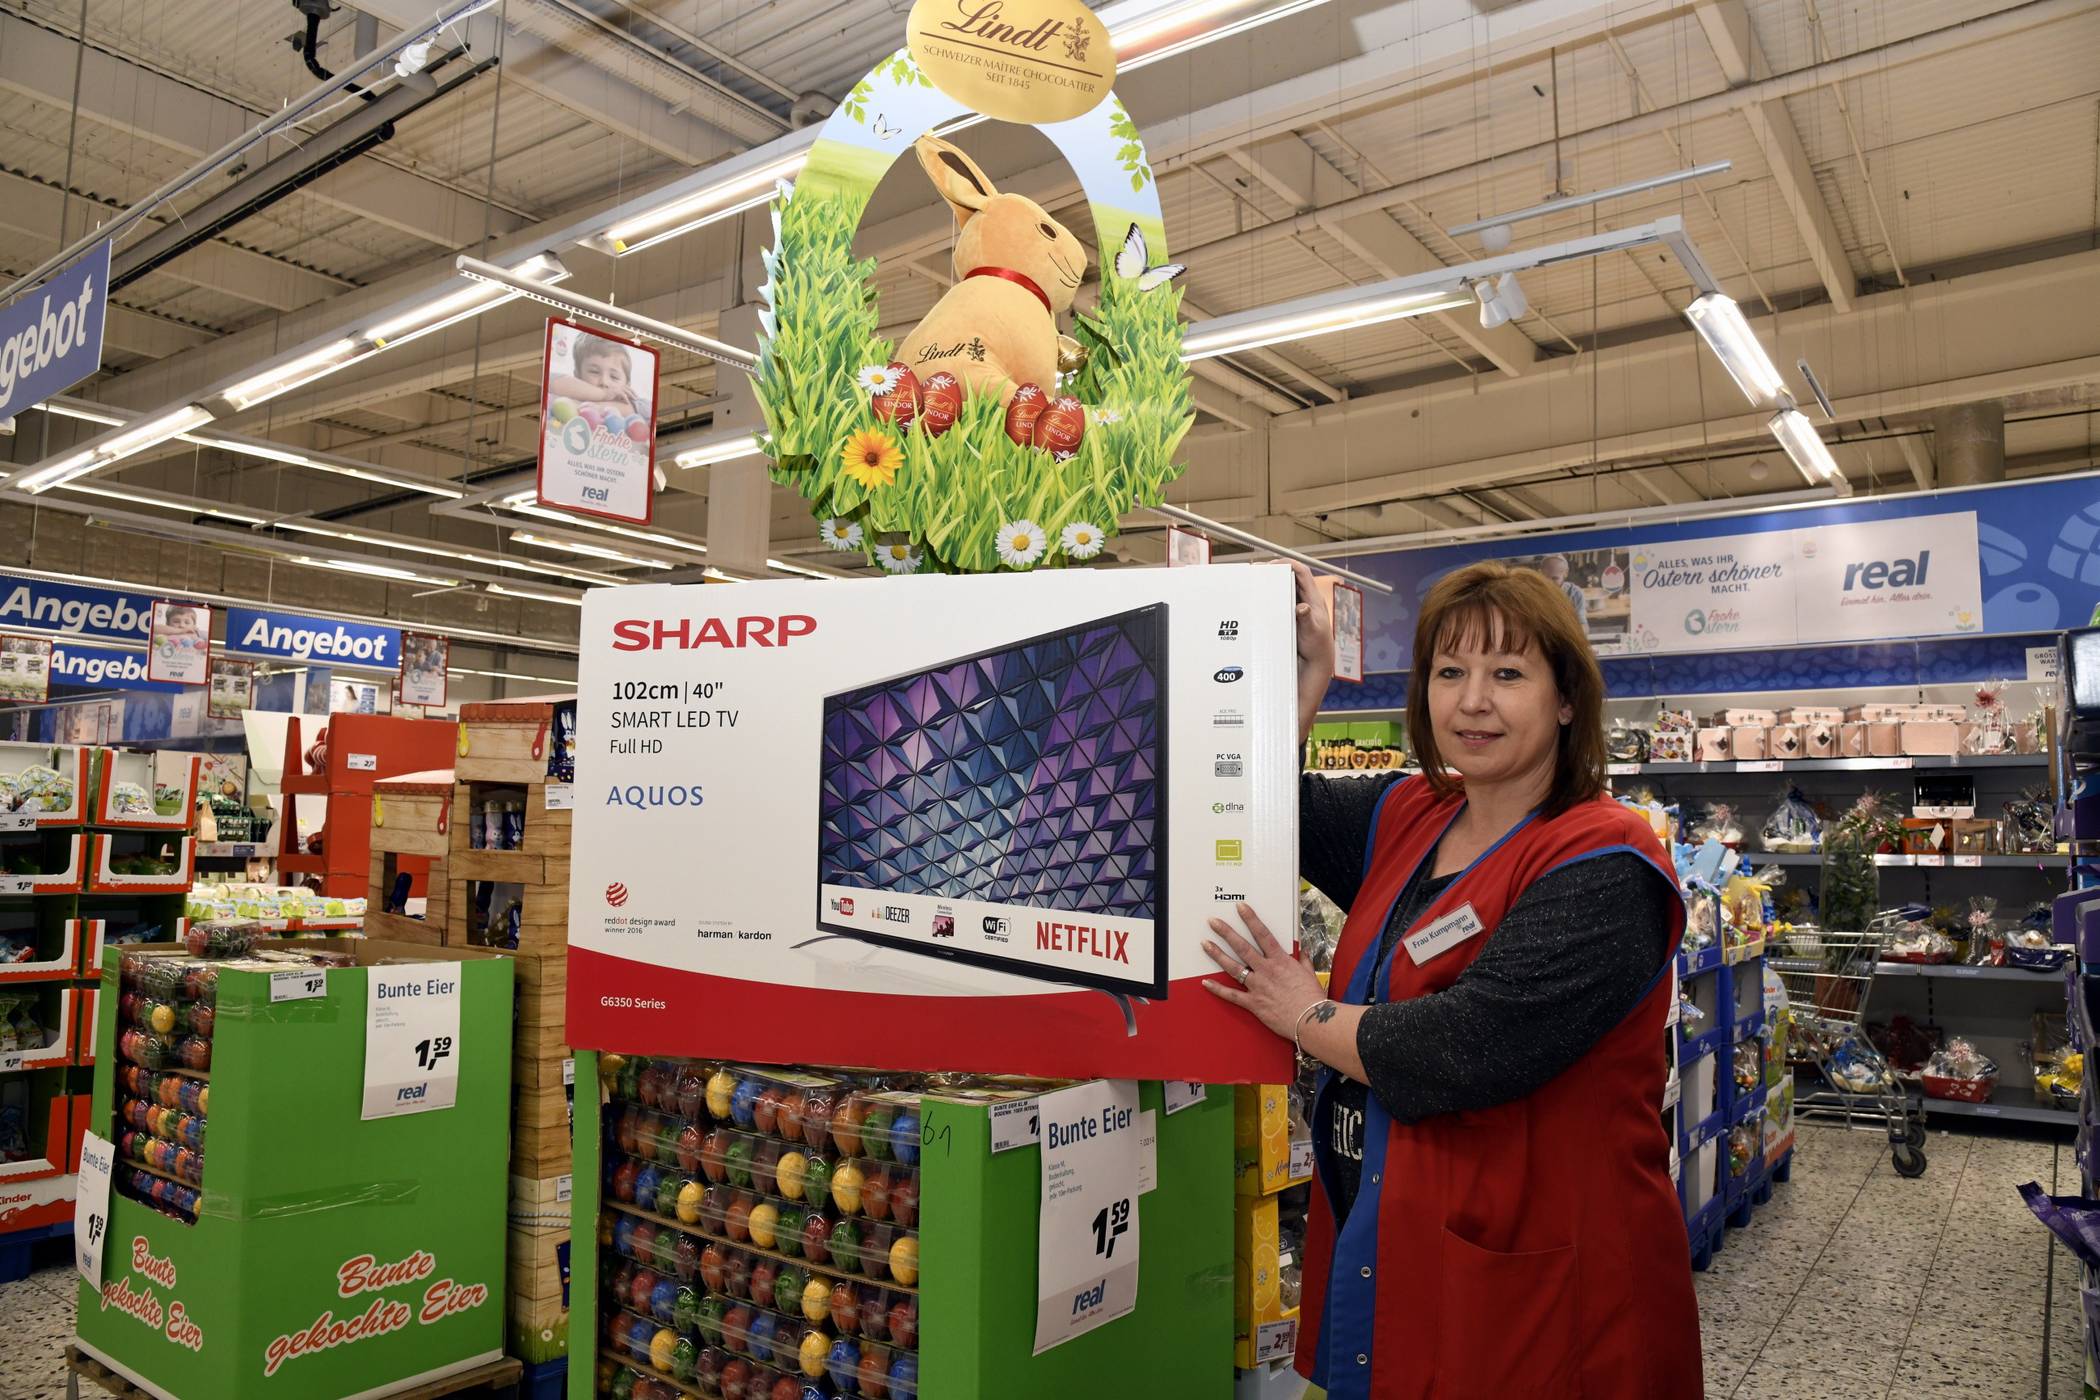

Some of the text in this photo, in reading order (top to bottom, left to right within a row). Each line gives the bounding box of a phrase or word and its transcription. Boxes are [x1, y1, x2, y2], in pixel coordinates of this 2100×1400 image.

[941, 0, 1064, 51] Lindt
[923, 45, 982, 66] SCHWEIZER
[1023, 68, 1095, 94] CHOCOLATIER
[986, 71, 1030, 90] SEIT 1845
[0, 273, 93, 408] gebot
[915, 342, 966, 366] Lindt
[593, 425, 632, 450] Frohe
[1045, 424, 1071, 441] LINDOR
[582, 485, 609, 502] real
[1658, 554, 1734, 570] ALLES, WAS IHR
[1842, 550, 1930, 592] real
[1643, 562, 1782, 590] Ostern schöner
[1711, 583, 1750, 595] MACHT.
[0, 586, 151, 633] Angebo
[1707, 607, 1740, 622] Frohe
[612, 614, 817, 651] SHARP
[1220, 620, 1239, 629] HD
[241, 618, 387, 660] Angebot
[1217, 672, 1236, 681] 400
[612, 682, 679, 700] 102cm
[611, 710, 739, 728] SMART LED TV
[610, 738, 663, 754] Full HD
[606, 785, 704, 810] AQUOS
[1225, 802, 1244, 811] dlna
[629, 917, 653, 927] design
[654, 919, 676, 927] award
[885, 906, 910, 924] DEEZER
[627, 927, 643, 935] 2016
[697, 929, 772, 941] harman kardon
[1036, 920, 1129, 965] NETFLIX
[1412, 914, 1468, 949] Frau Kumpmann
[378, 979, 455, 999] Bunte Eier
[600, 996, 666, 1009] G6350 Series
[415, 1037, 452, 1071] 1,59
[397, 1083, 427, 1101] real
[1049, 1105, 1132, 1149] Bunte Eier
[82, 1146, 110, 1175] Bunte Eier
[1092, 1198, 1130, 1259] 1,59
[82, 1251, 92, 1269] real
[133, 1237, 175, 1285] Bunte
[339, 1253, 433, 1295] Bunte
[1072, 1279, 1106, 1315] real
[102, 1280, 202, 1350] gekochte Eier
[267, 1280, 486, 1375] gekochte Eier
